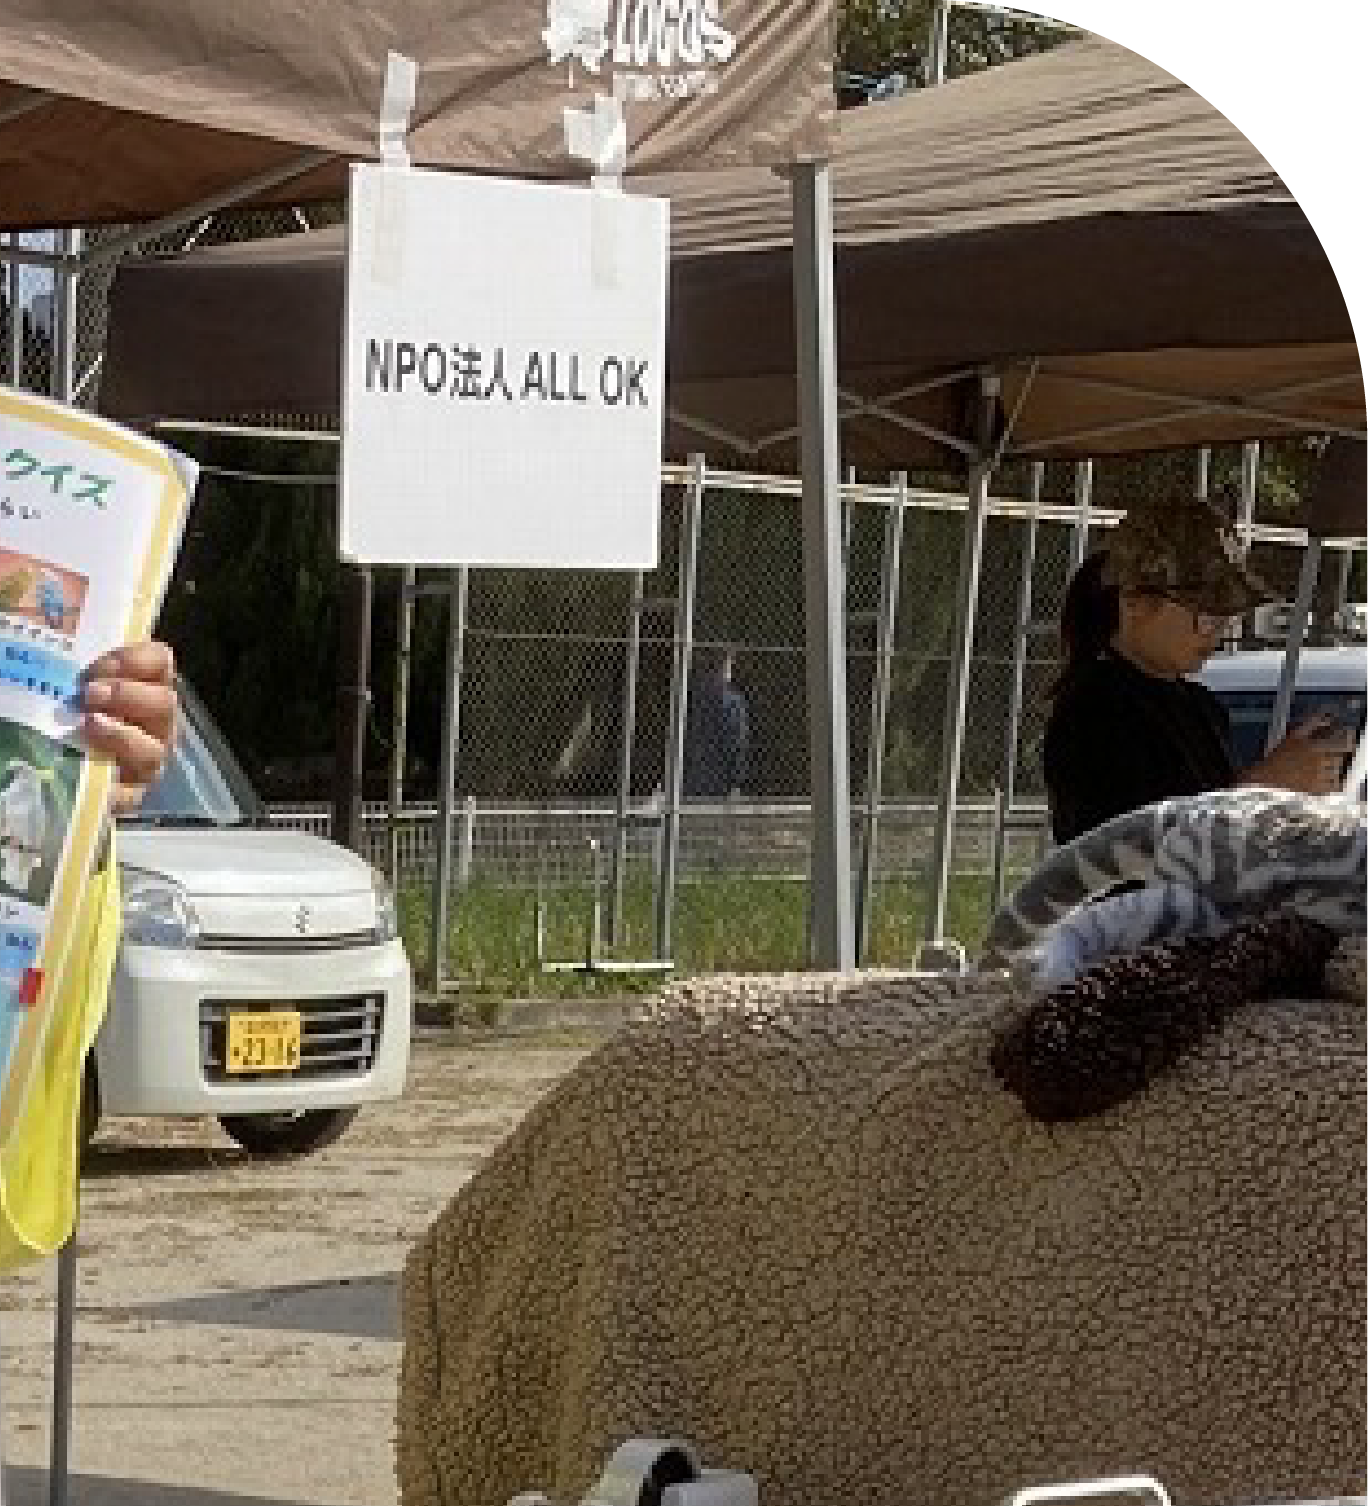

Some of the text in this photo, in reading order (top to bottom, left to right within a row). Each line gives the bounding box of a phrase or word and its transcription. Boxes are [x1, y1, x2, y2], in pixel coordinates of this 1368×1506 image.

[364, 338, 649, 406] NPO法人 ALL OK
[3, 446, 114, 509] クイズ
